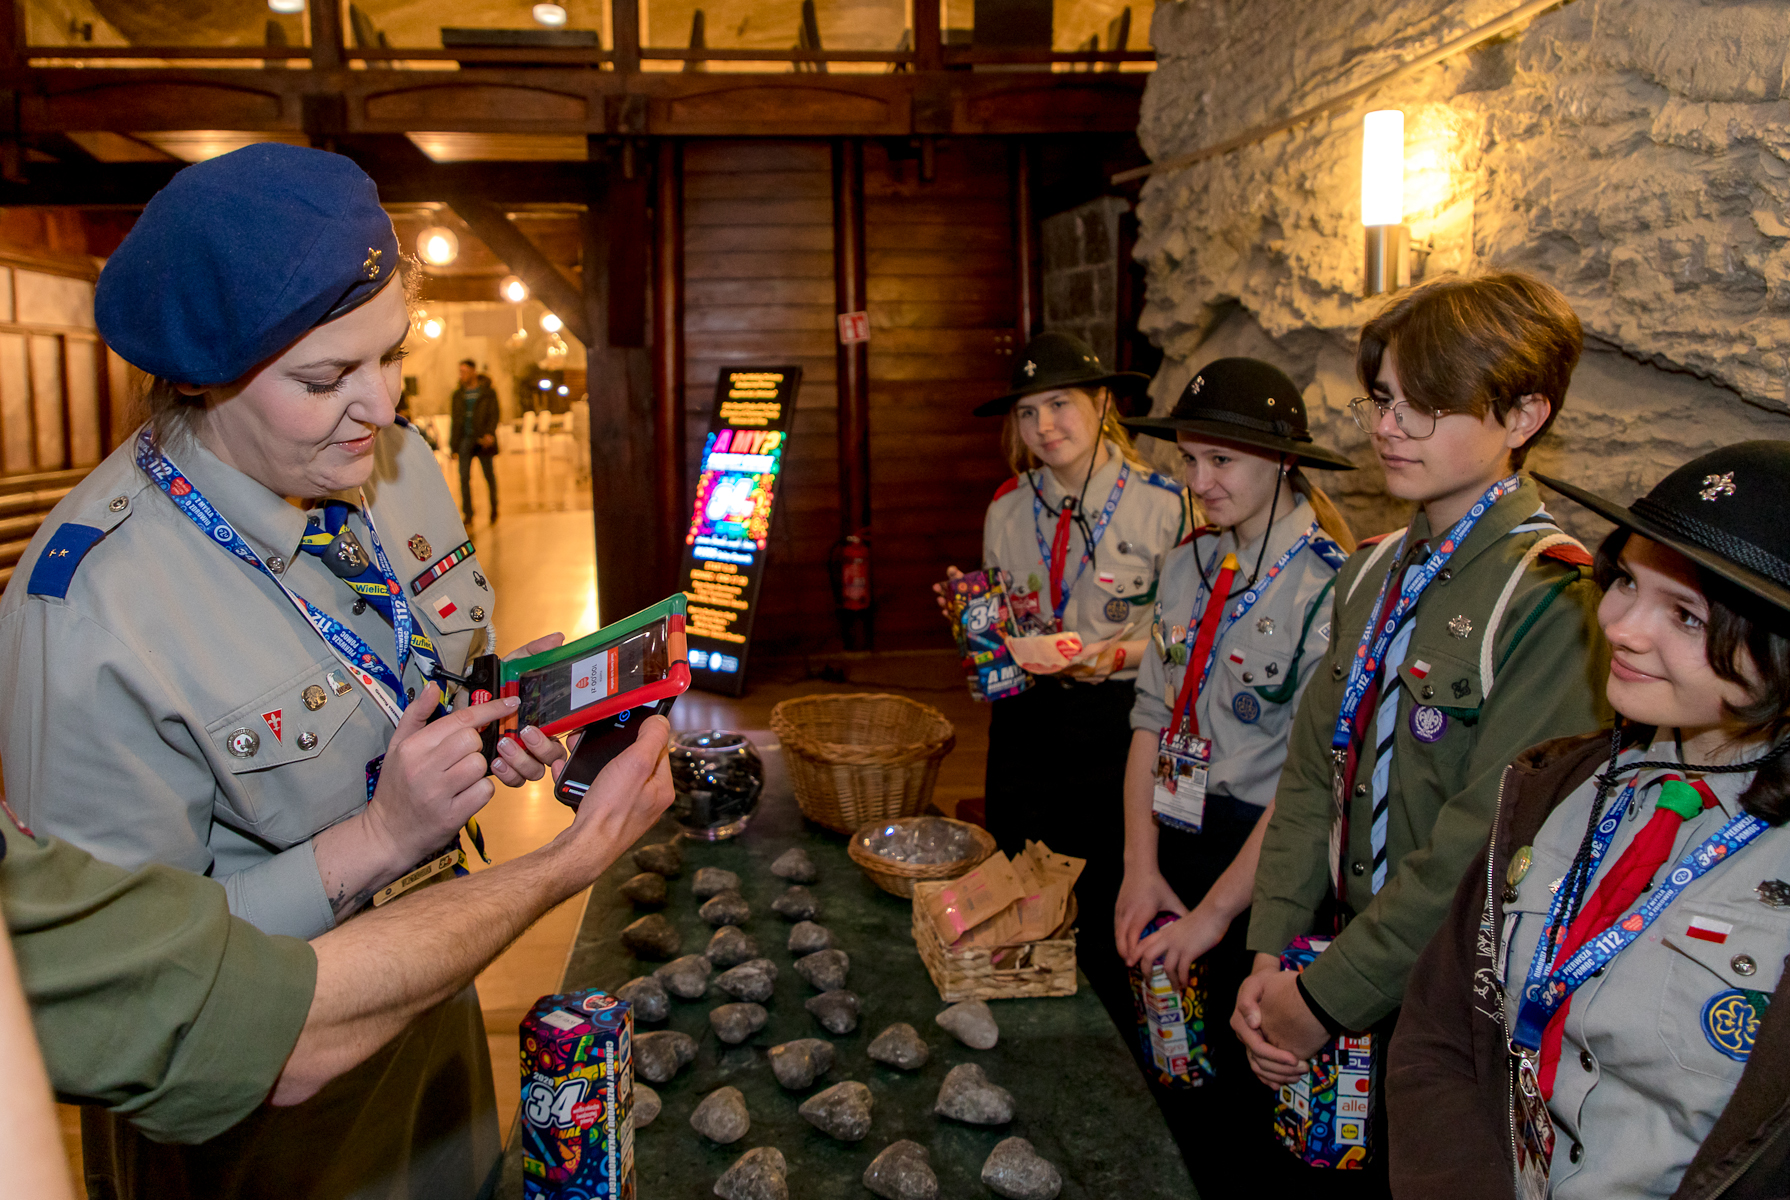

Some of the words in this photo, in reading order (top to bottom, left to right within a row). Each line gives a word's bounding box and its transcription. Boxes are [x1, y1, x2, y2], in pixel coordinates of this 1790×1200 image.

[712, 429, 733, 453] A
[1487, 487, 1499, 501] 34
[188, 504, 212, 526] ZDROWIU
[1426, 555, 1444, 573] 112
[395, 600, 409, 621] 112
[970, 596, 1000, 631] 34
[312, 612, 333, 633] 112
[332, 634, 357, 657] PIERWSZA
[340, 630, 360, 651] POMOC
[1356, 673, 1370, 691] 112
[1723, 815, 1757, 840] PIERWSZA
[1734, 823, 1761, 843] POMOC
[1590, 839, 1603, 859] 34
[1699, 844, 1718, 867] 34
[1596, 931, 1625, 954] 112
[1562, 949, 1593, 976] PIERWSZA
[1573, 958, 1596, 980] POMOC
[1542, 981, 1558, 1006] 34
[605, 1041, 615, 1081] CHOROBY
[527, 1081, 586, 1126] 34
[606, 1081, 616, 1127] PRZEWODU
[1342, 1100, 1367, 1112] alle
[607, 1128, 617, 1192] POKARMOWEGO
